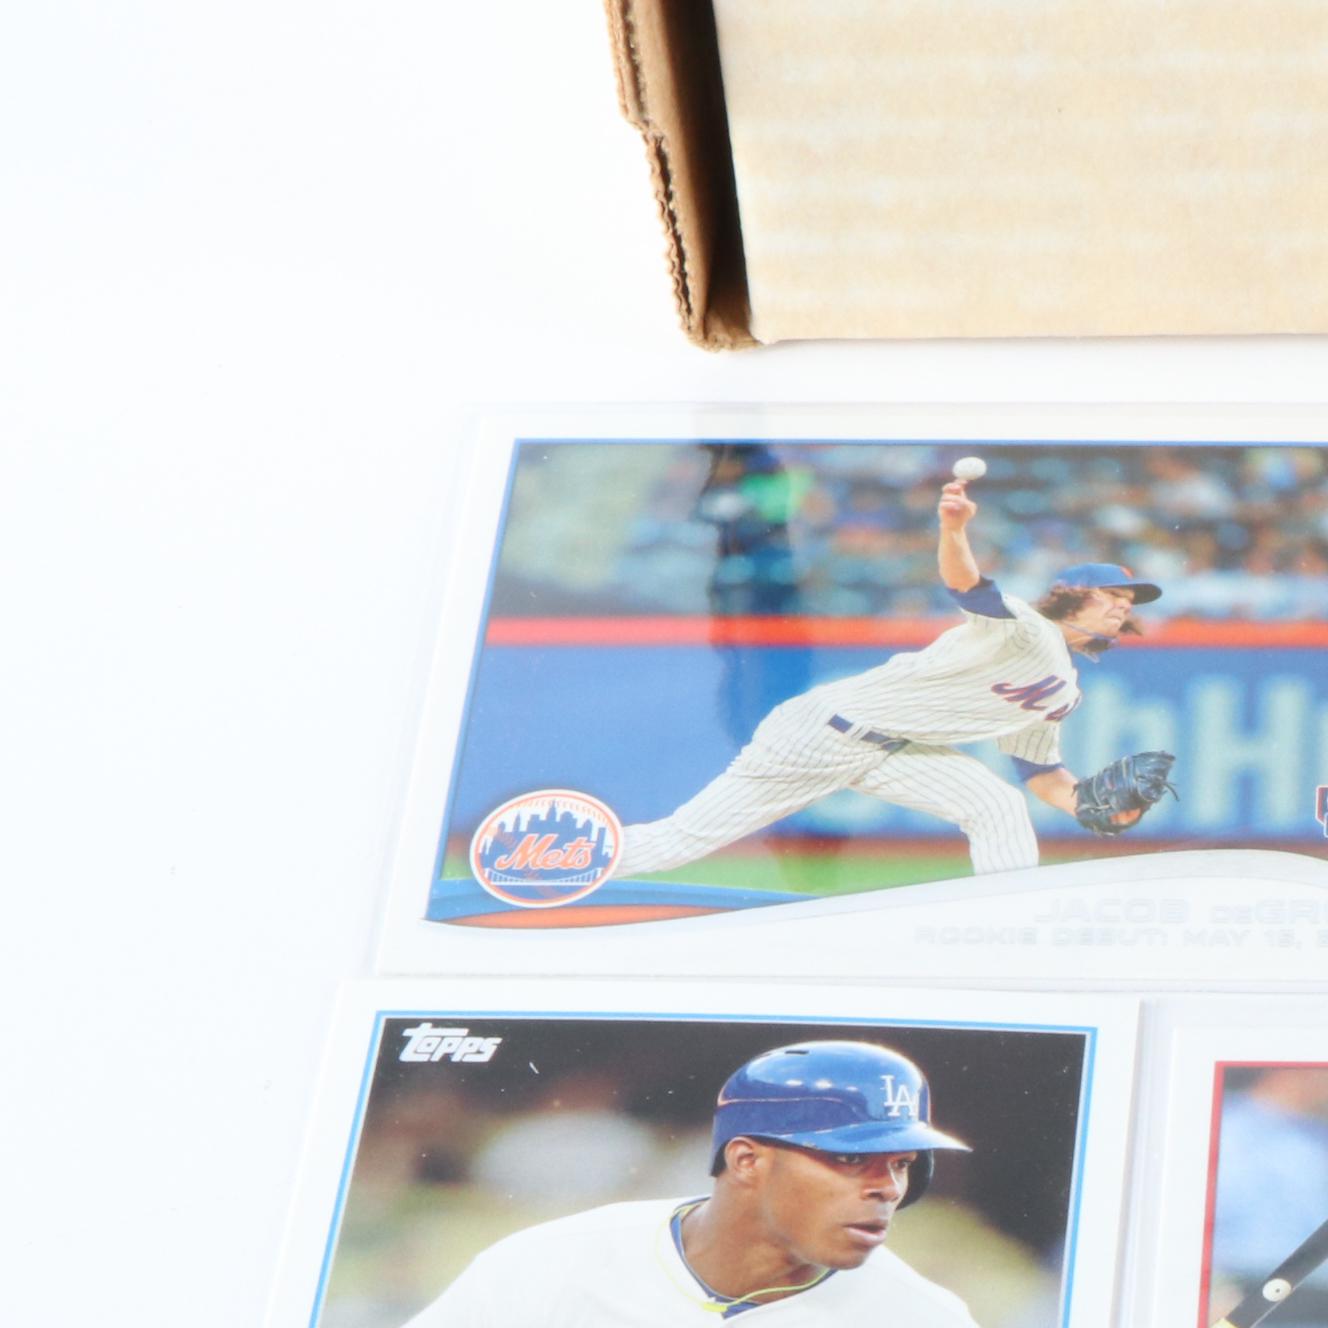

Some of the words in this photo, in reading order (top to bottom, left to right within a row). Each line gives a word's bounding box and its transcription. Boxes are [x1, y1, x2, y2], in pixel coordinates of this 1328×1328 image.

[495, 834, 594, 871] Mets
[1033, 898, 1191, 924] JACOB
[914, 925, 1038, 946] ROOKIE
[1182, 928, 1252, 948] MAY
[880, 1074, 918, 1117] LA
